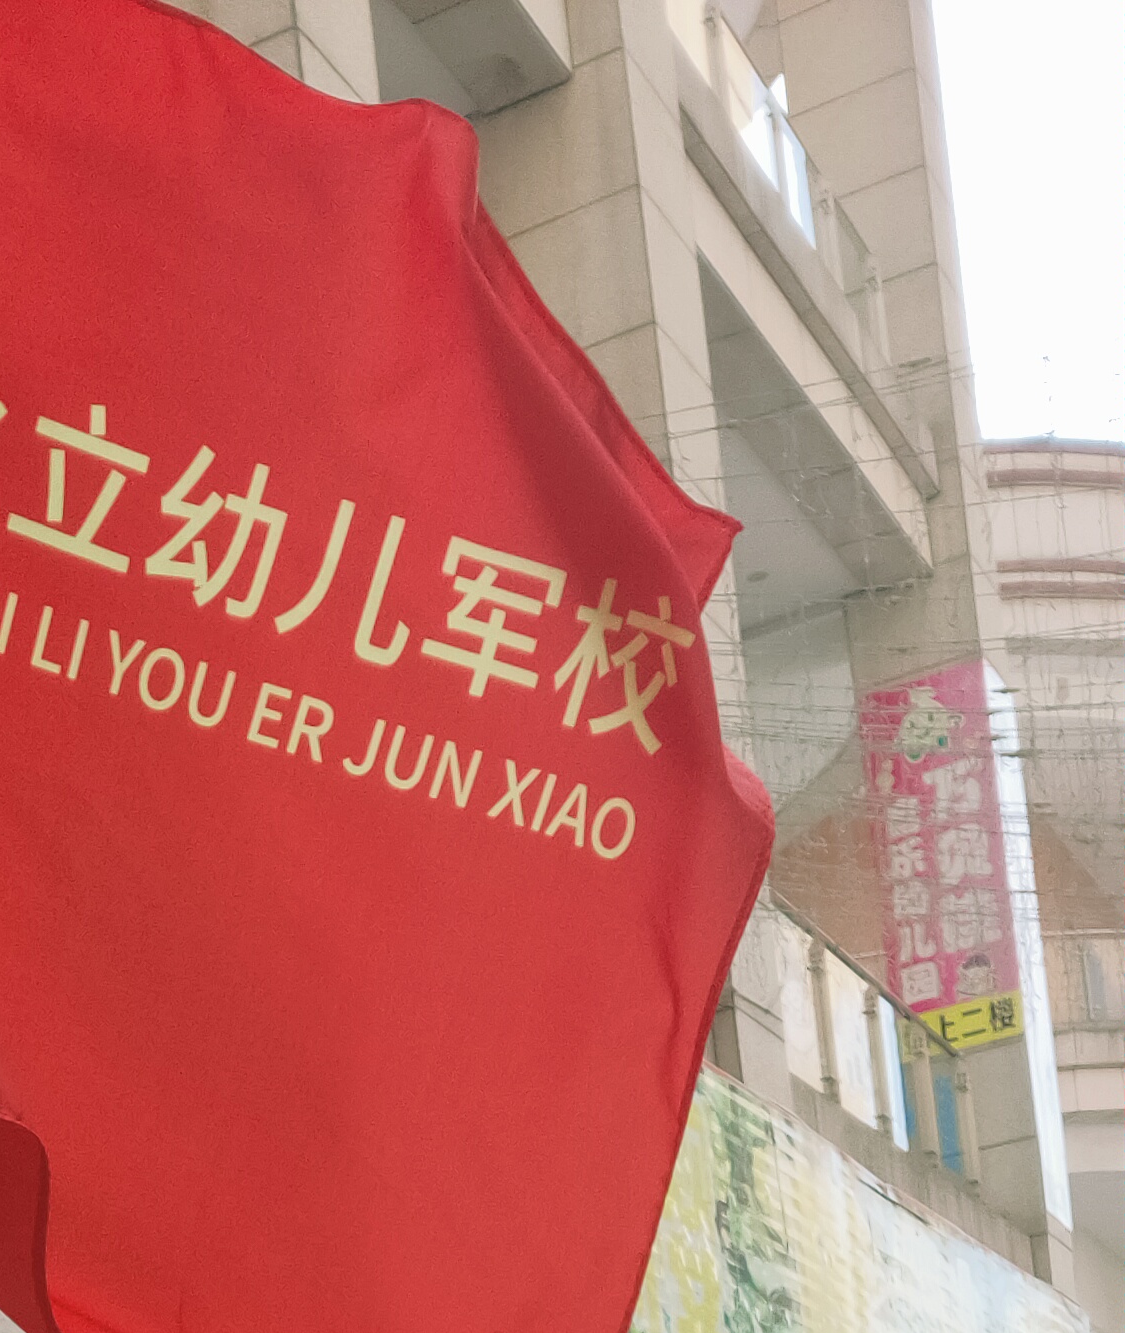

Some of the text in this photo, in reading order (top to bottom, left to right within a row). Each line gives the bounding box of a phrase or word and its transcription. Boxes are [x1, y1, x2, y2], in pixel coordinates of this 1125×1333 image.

[31, 605, 90, 680] LI
[108, 629, 237, 728] YOU
[247, 681, 335, 764] ER
[342, 718, 483, 809] JUN
[487, 757, 637, 859] XIAO
